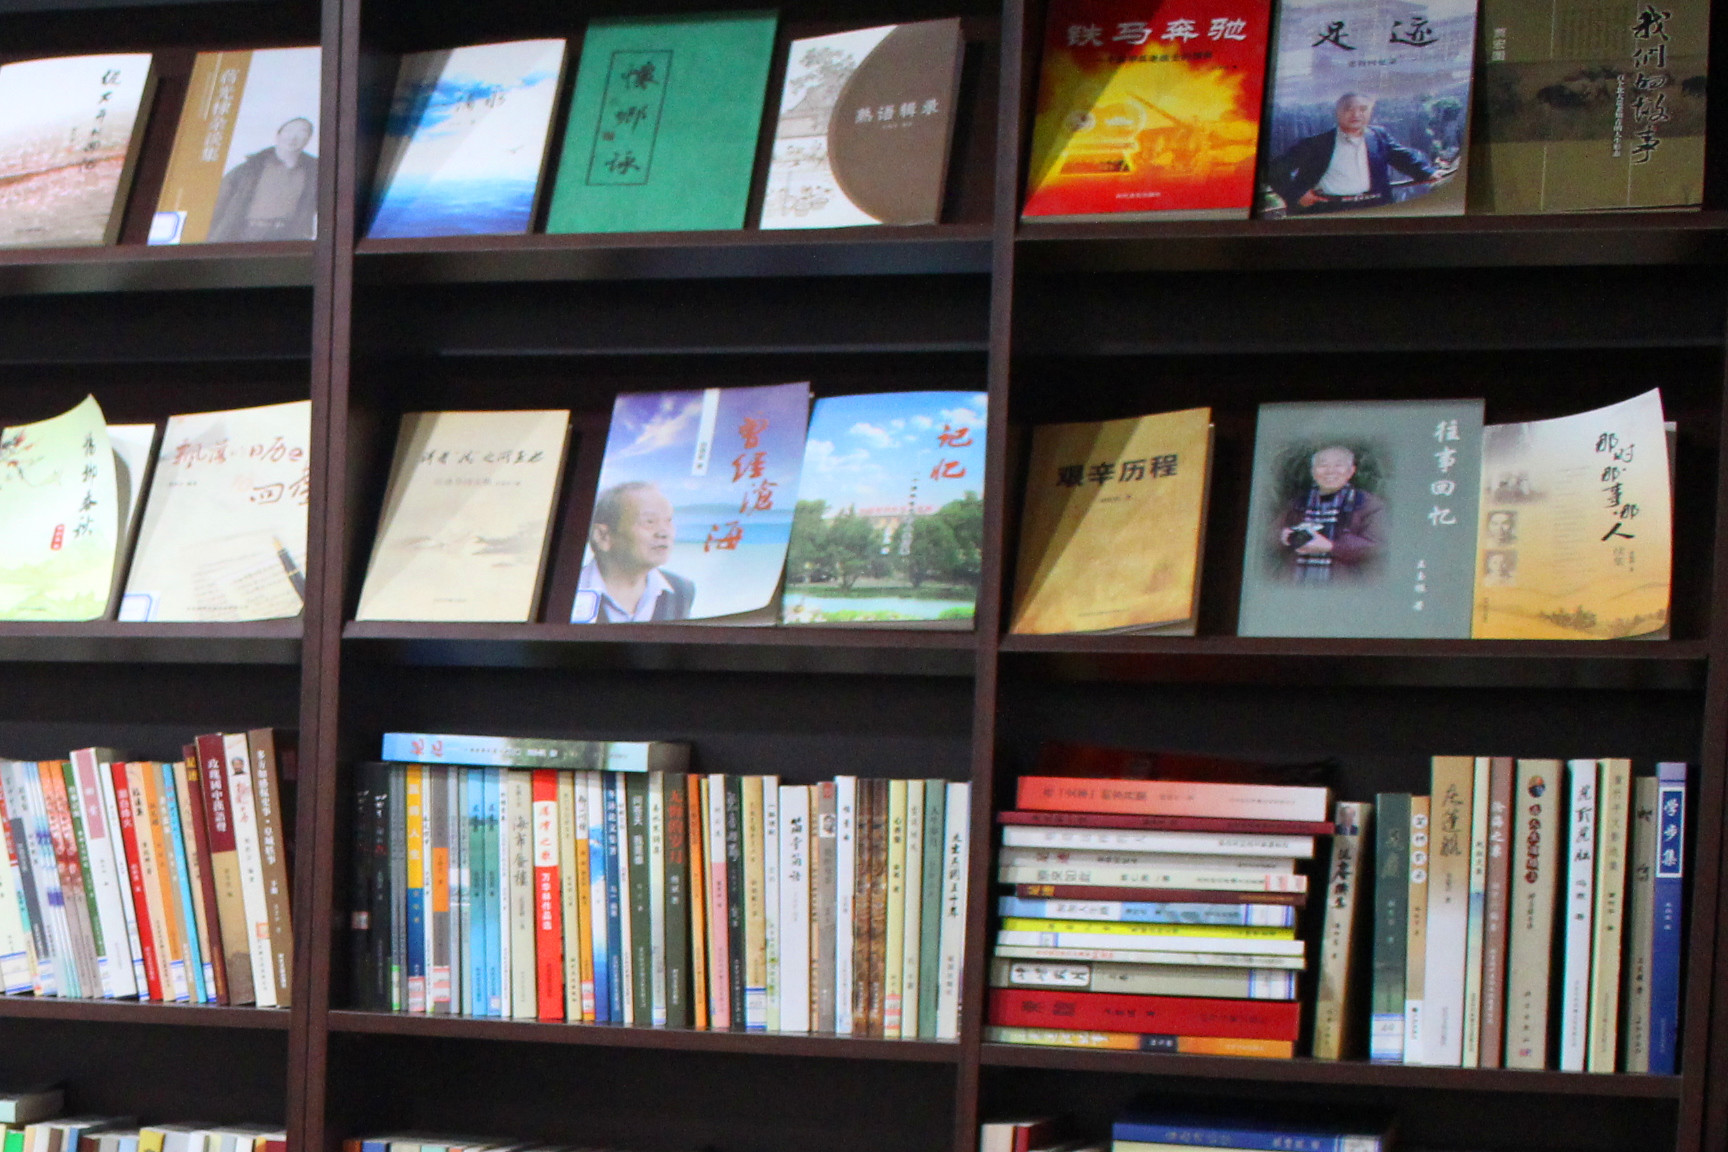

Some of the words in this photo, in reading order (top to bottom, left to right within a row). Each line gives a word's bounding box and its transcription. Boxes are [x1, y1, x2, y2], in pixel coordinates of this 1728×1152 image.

[1311, 18, 1439, 50] 足迹
[930, 424, 974, 483] 记忆
[1056, 453, 1179, 488] 艰辛历程
[1427, 419, 1460, 526] 往事回忆
